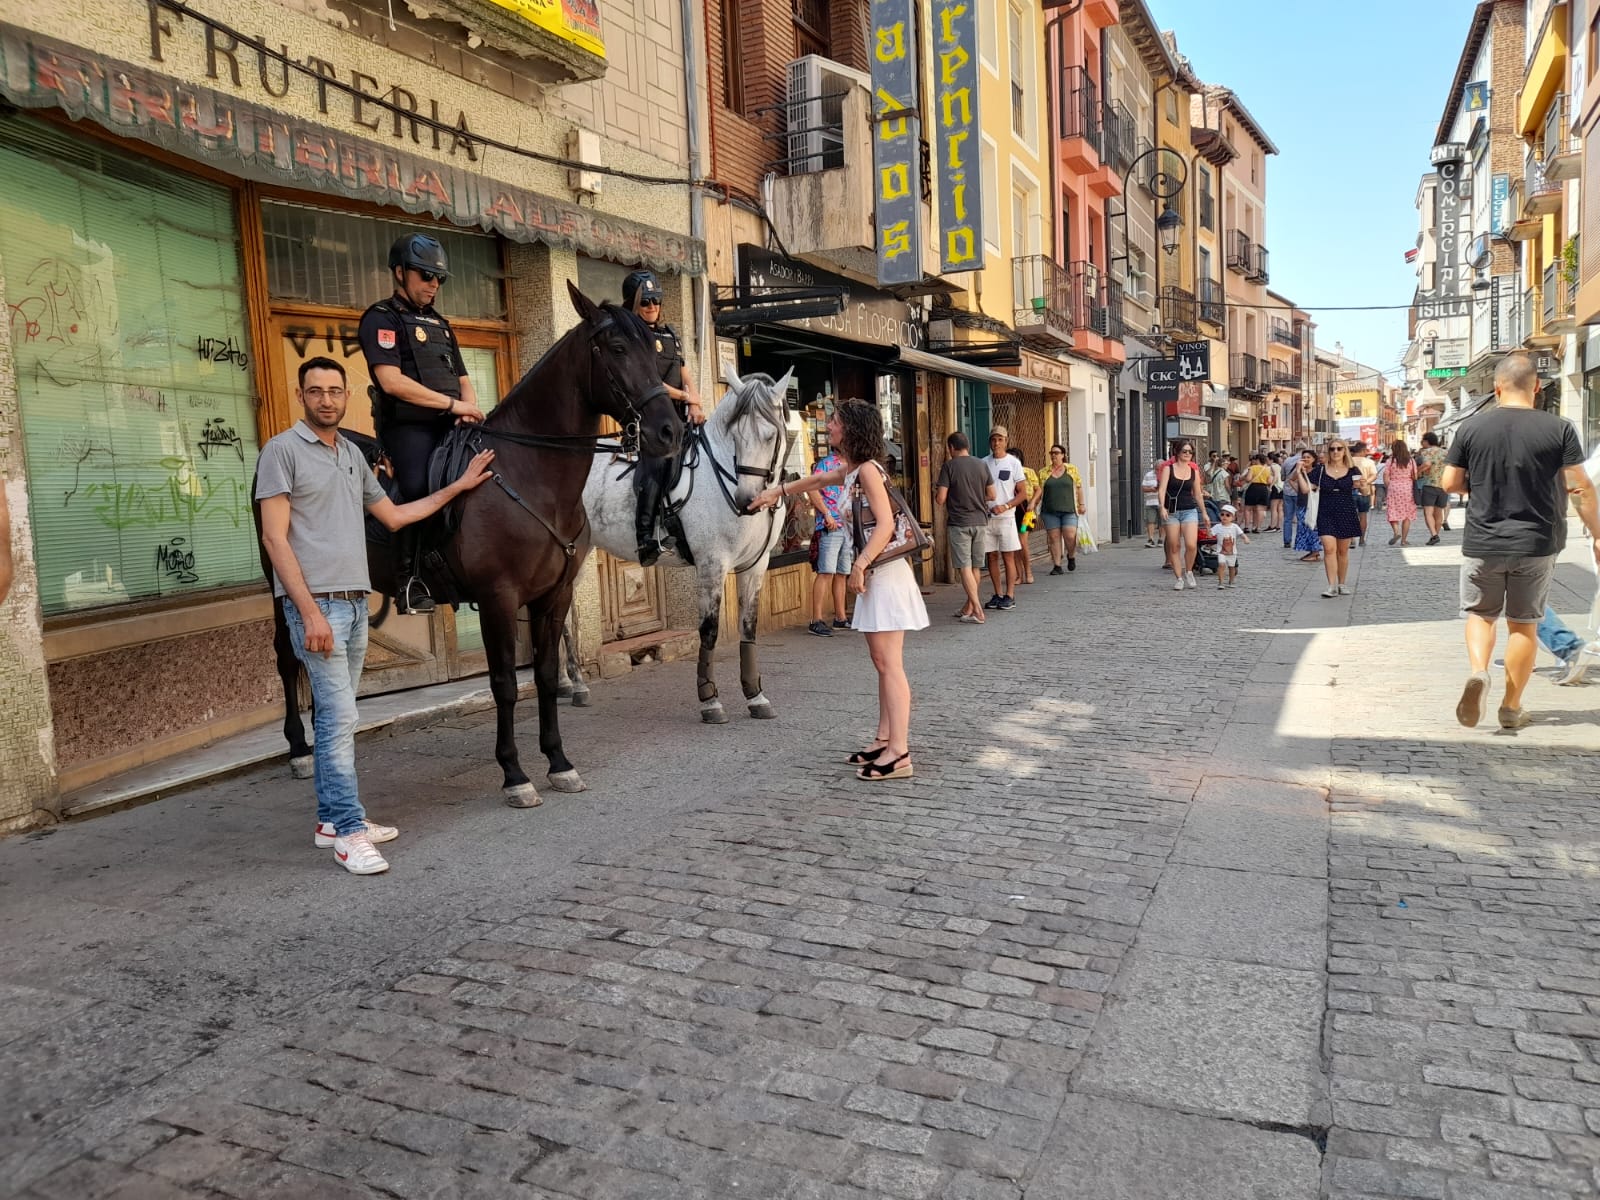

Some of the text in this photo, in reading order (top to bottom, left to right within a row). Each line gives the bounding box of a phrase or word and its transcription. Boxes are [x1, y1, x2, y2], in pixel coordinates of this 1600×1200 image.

[148, 0, 478, 162] FRUTERIA
[1440, 163, 1457, 298] COMERCIAL
[857, 302, 919, 349] FLORENCIO
[1418, 300, 1469, 319] ISILLA
[1178, 342, 1207, 351] VINOS
[1150, 371, 1177, 382] CKC
